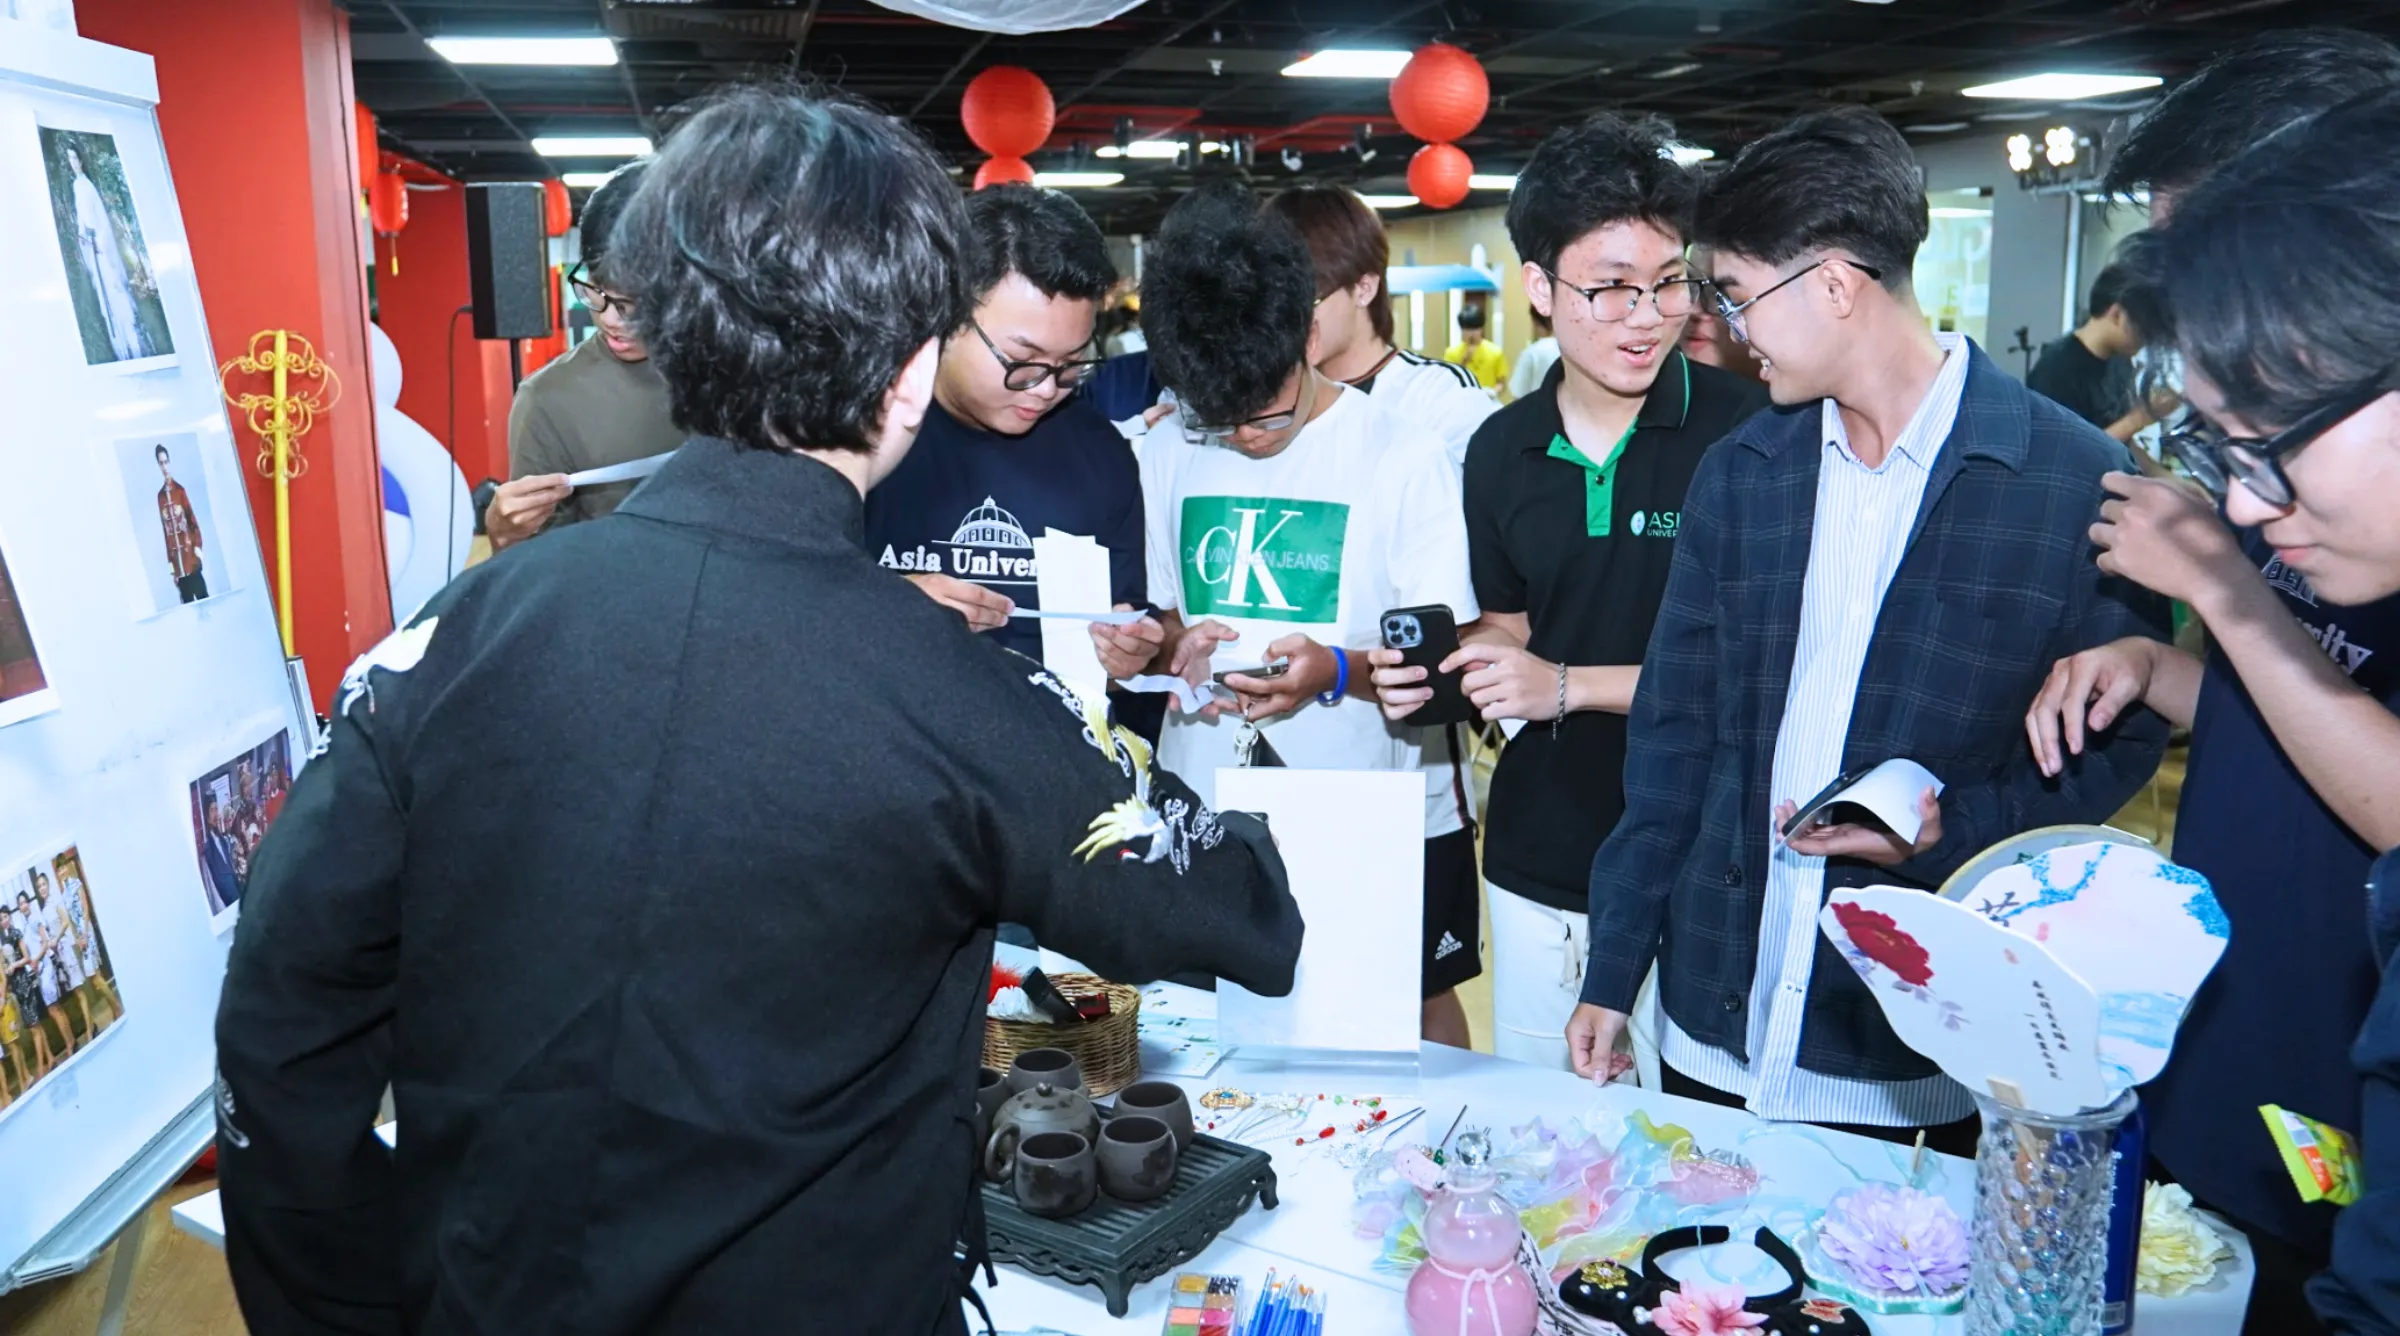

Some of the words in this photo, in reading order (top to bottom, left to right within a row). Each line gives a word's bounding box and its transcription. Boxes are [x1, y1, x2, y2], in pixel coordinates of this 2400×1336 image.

[1648, 511, 1681, 528] ASI
[877, 543, 942, 572] Asia
[1184, 545, 1233, 564] CVIN
[1277, 550, 1331, 571] JEANS
